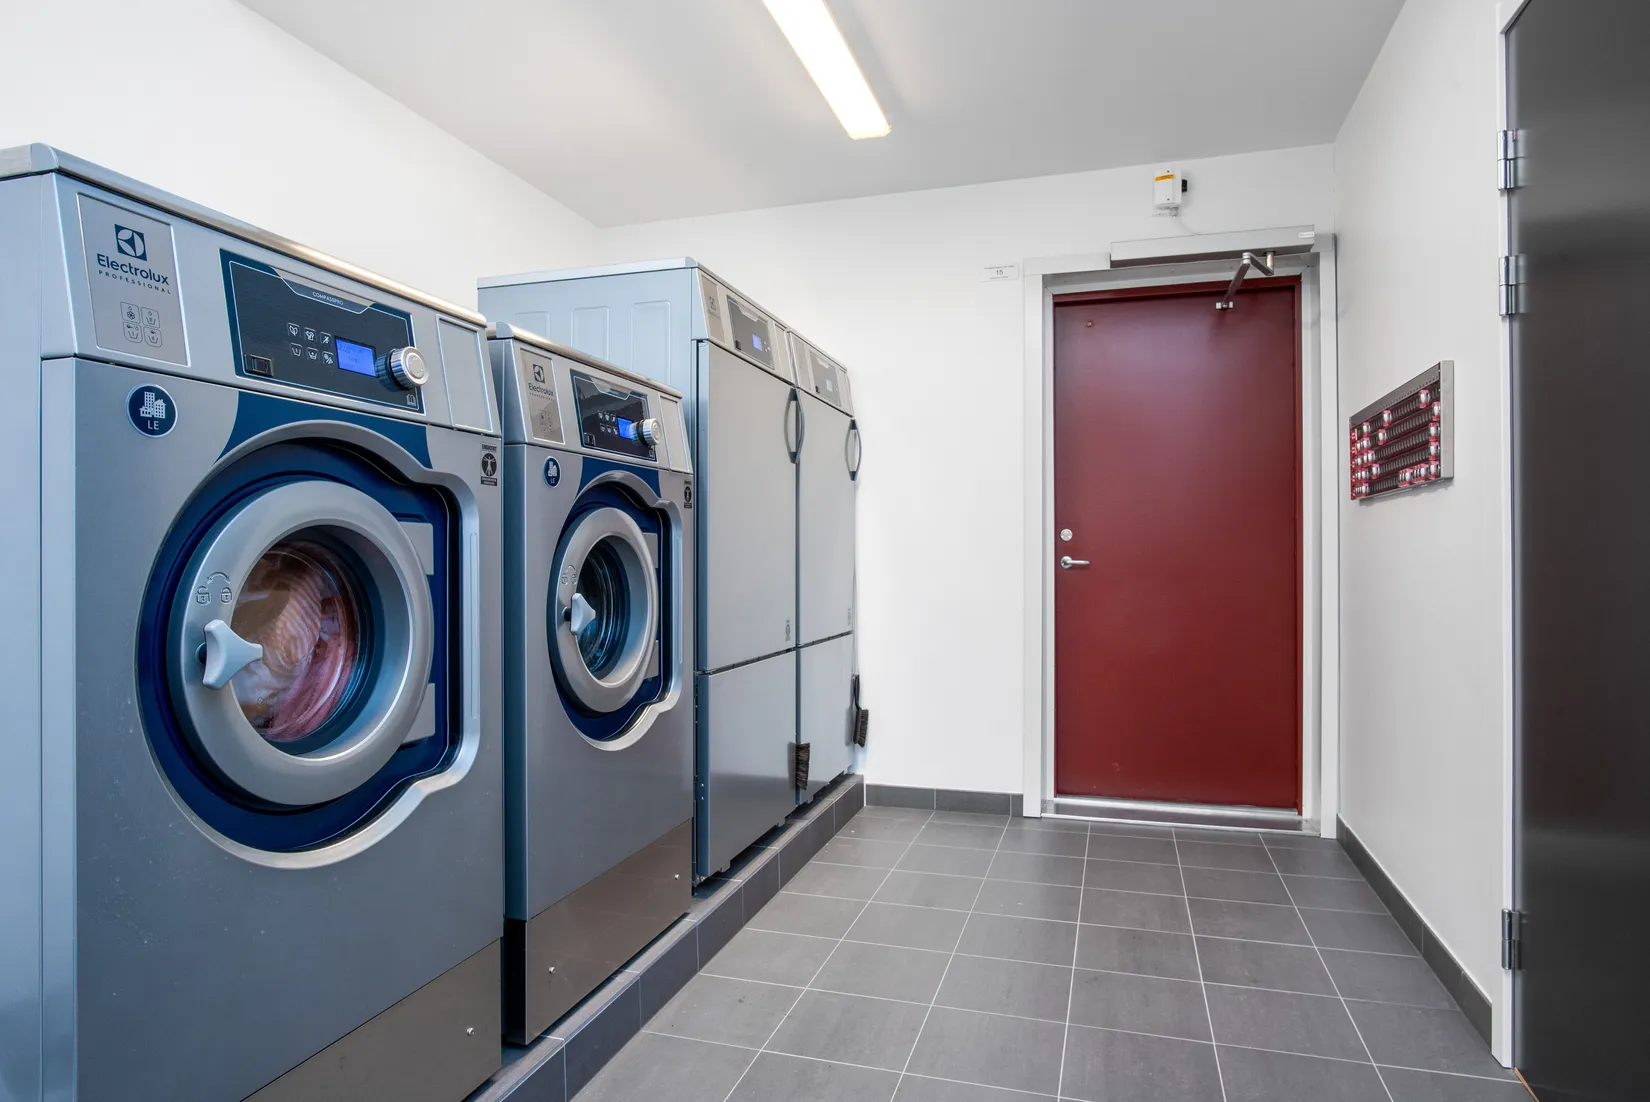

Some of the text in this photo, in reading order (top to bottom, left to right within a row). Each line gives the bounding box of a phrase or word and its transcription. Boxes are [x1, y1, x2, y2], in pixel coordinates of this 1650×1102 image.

[97, 253, 170, 286] Electrolux
[98, 269, 171, 295] PROFESSIONAL
[147, 420, 160, 431] LE
